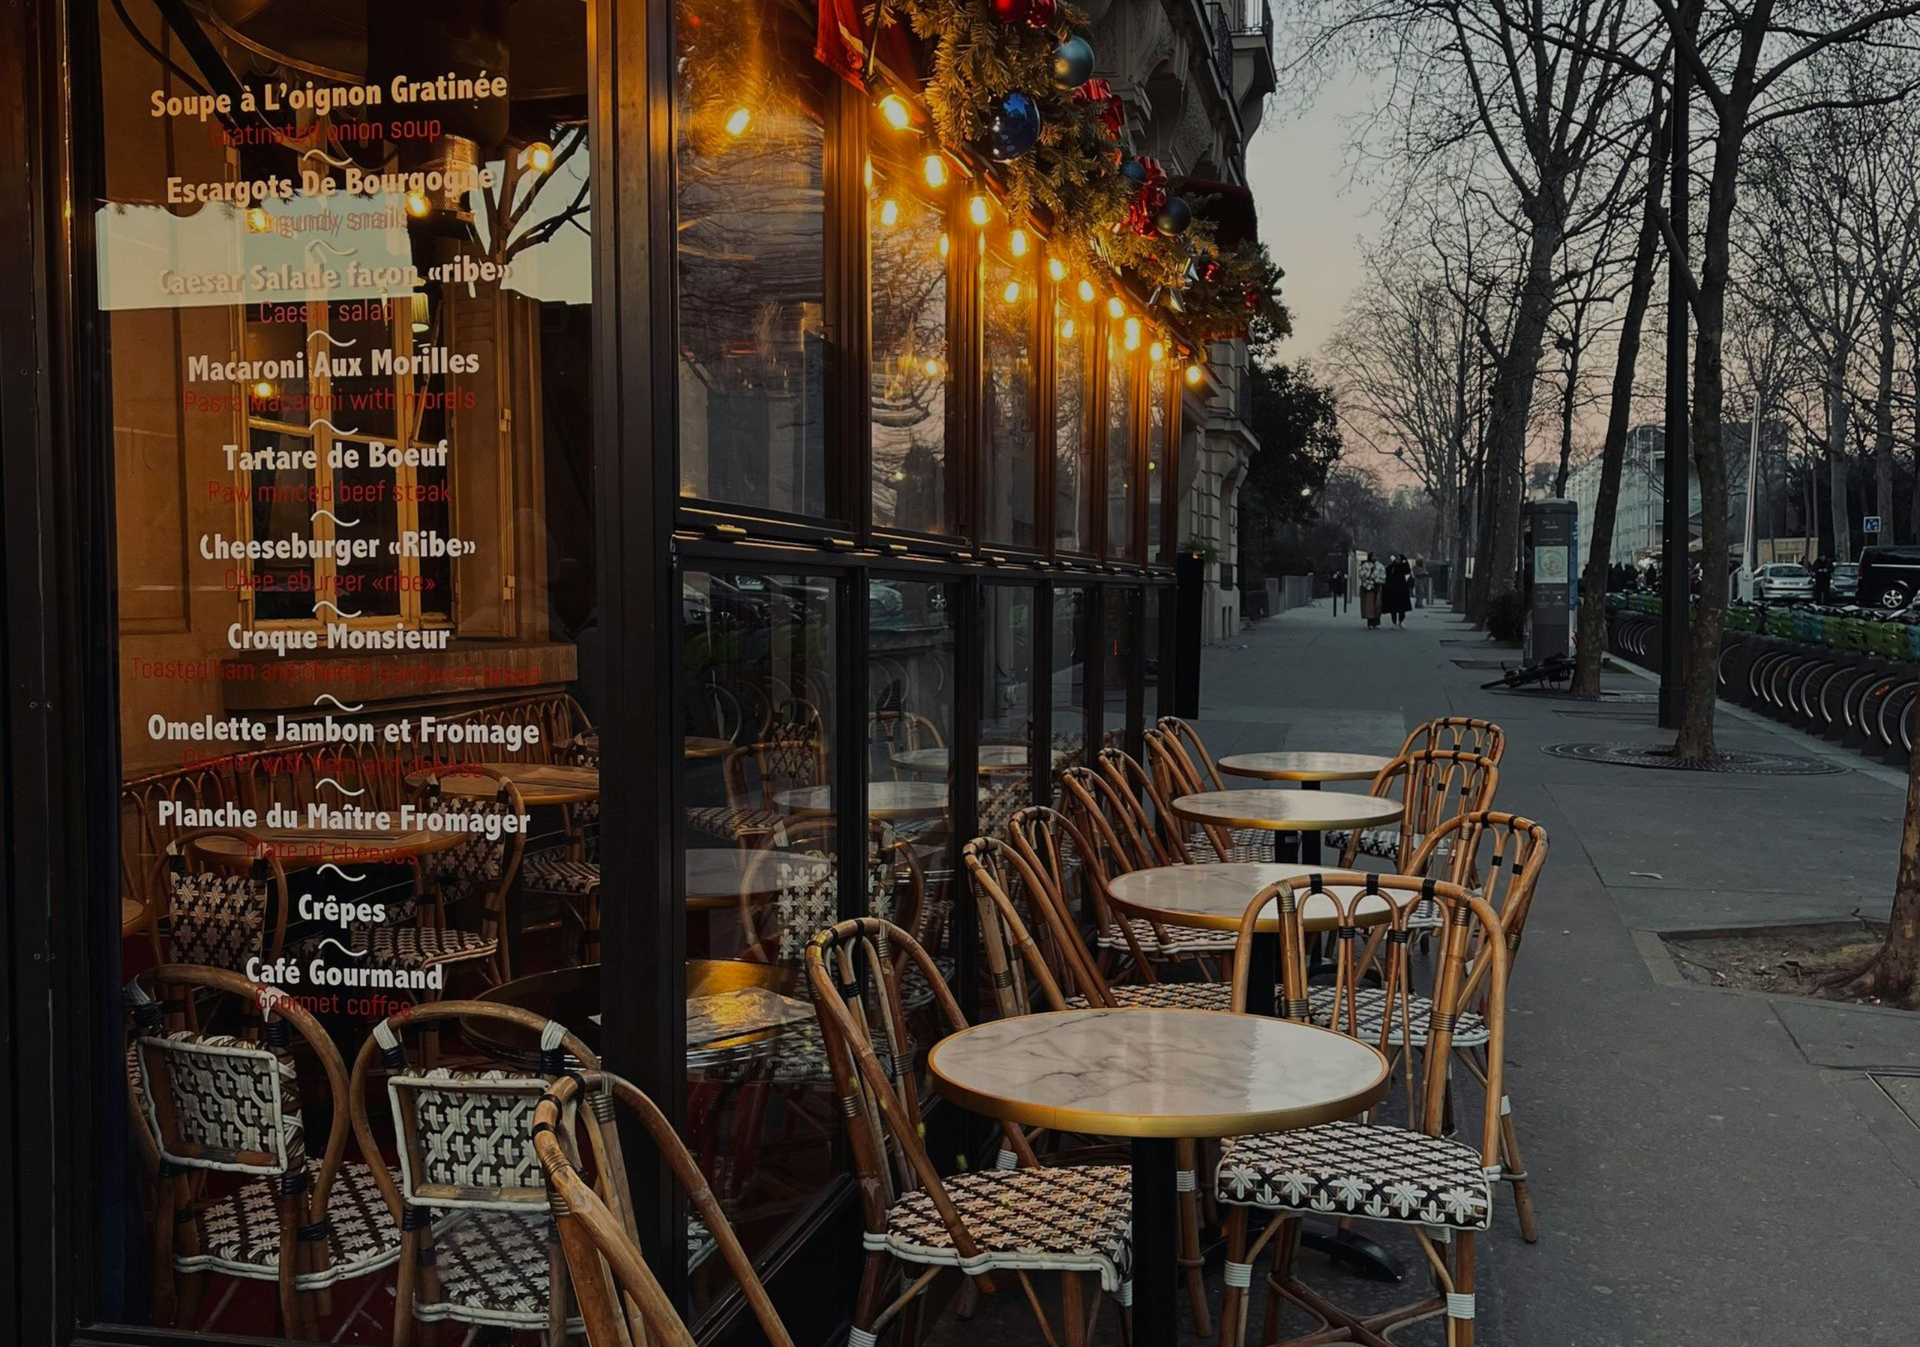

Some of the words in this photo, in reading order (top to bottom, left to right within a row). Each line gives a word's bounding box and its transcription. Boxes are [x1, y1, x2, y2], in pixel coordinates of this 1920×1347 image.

[151, 89, 231, 122] Soupe
[240, 85, 256, 112] à
[264, 82, 381, 116] L’oignon
[391, 70, 507, 104] Gratinée
[209, 121, 321, 147] Gratinated
[328, 119, 383, 142] onion
[391, 119, 441, 142] soup
[167, 173, 292, 208] Escargots
[302, 170, 337, 198] De
[345, 165, 497, 203] Bourgogne
[158, 269, 242, 296] Caesar
[250, 264, 338, 292] Salade
[347, 261, 418, 295] façon
[428, 255, 510, 283] «ribe»
[260, 301, 331, 324] Caesar
[339, 297, 394, 322] salad
[188, 352, 304, 382] Macaroni
[314, 351, 361, 379] Aux
[371, 346, 480, 376] Morilles
[183, 391, 242, 412] Pasta
[250, 389, 342, 412] Macaroni
[349, 388, 395, 409] with
[403, 389, 476, 409] morels
[222, 444, 317, 471] Tartare
[327, 442, 359, 468] de
[369, 439, 448, 468] Boeuf
[258, 479, 331, 503] minced
[339, 478, 385, 502] beef
[392, 479, 451, 502] steak
[200, 531, 379, 565] Cheeseburger
[389, 530, 476, 558] «Ribe»
[224, 569, 365, 597] Cheeeburger
[372, 569, 436, 591] «ribe»
[228, 622, 317, 657] Croque
[328, 622, 450, 650] Monsieur
[131, 657, 208, 680] Toasted
[214, 658, 255, 680] ham
[147, 713, 266, 741] Omelette
[275, 715, 374, 742] Jambon
[384, 719, 413, 743] et
[421, 716, 540, 752] Fromage
[158, 800, 257, 829] Planche
[266, 802, 298, 829] du
[308, 802, 390, 831] Maître
[401, 804, 531, 840] Fromager
[305, 840, 325, 861] of
[332, 842, 418, 866] cheeses
[298, 893, 387, 929] Crêpes
[246, 956, 300, 984] Café
[309, 958, 443, 990] Gourmand
[255, 988, 340, 1014] Gourmet
[346, 994, 412, 1019] coffee
